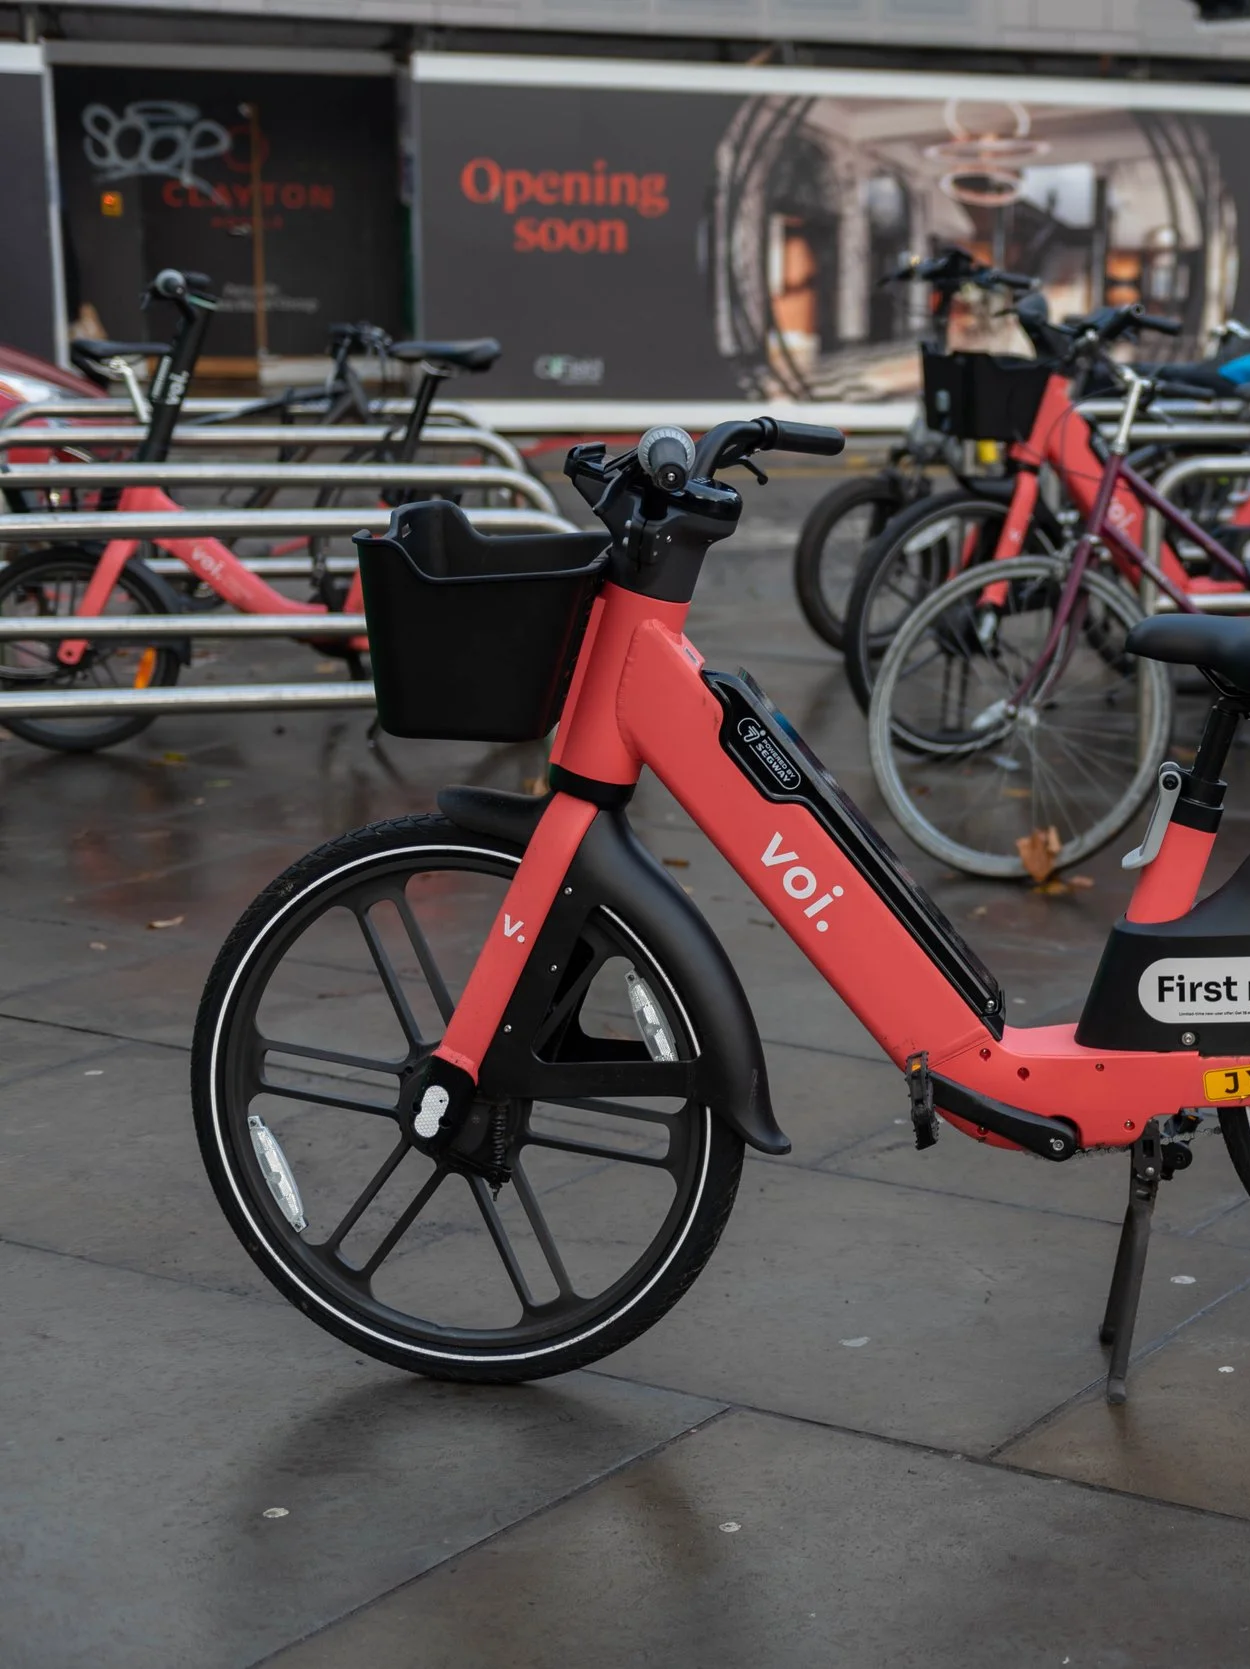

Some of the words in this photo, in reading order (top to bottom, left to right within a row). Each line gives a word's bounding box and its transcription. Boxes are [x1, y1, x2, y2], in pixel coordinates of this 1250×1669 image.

[461, 157, 669, 218] Opening
[514, 217, 628, 253] soon
[756, 743, 791, 782] SEGWAY
[761, 739, 788, 769] POWERED
[786, 769, 796, 778] BY
[761, 831, 844, 932] voi.
[504, 913, 525, 943] v.
[1158, 974, 1238, 1002] First
